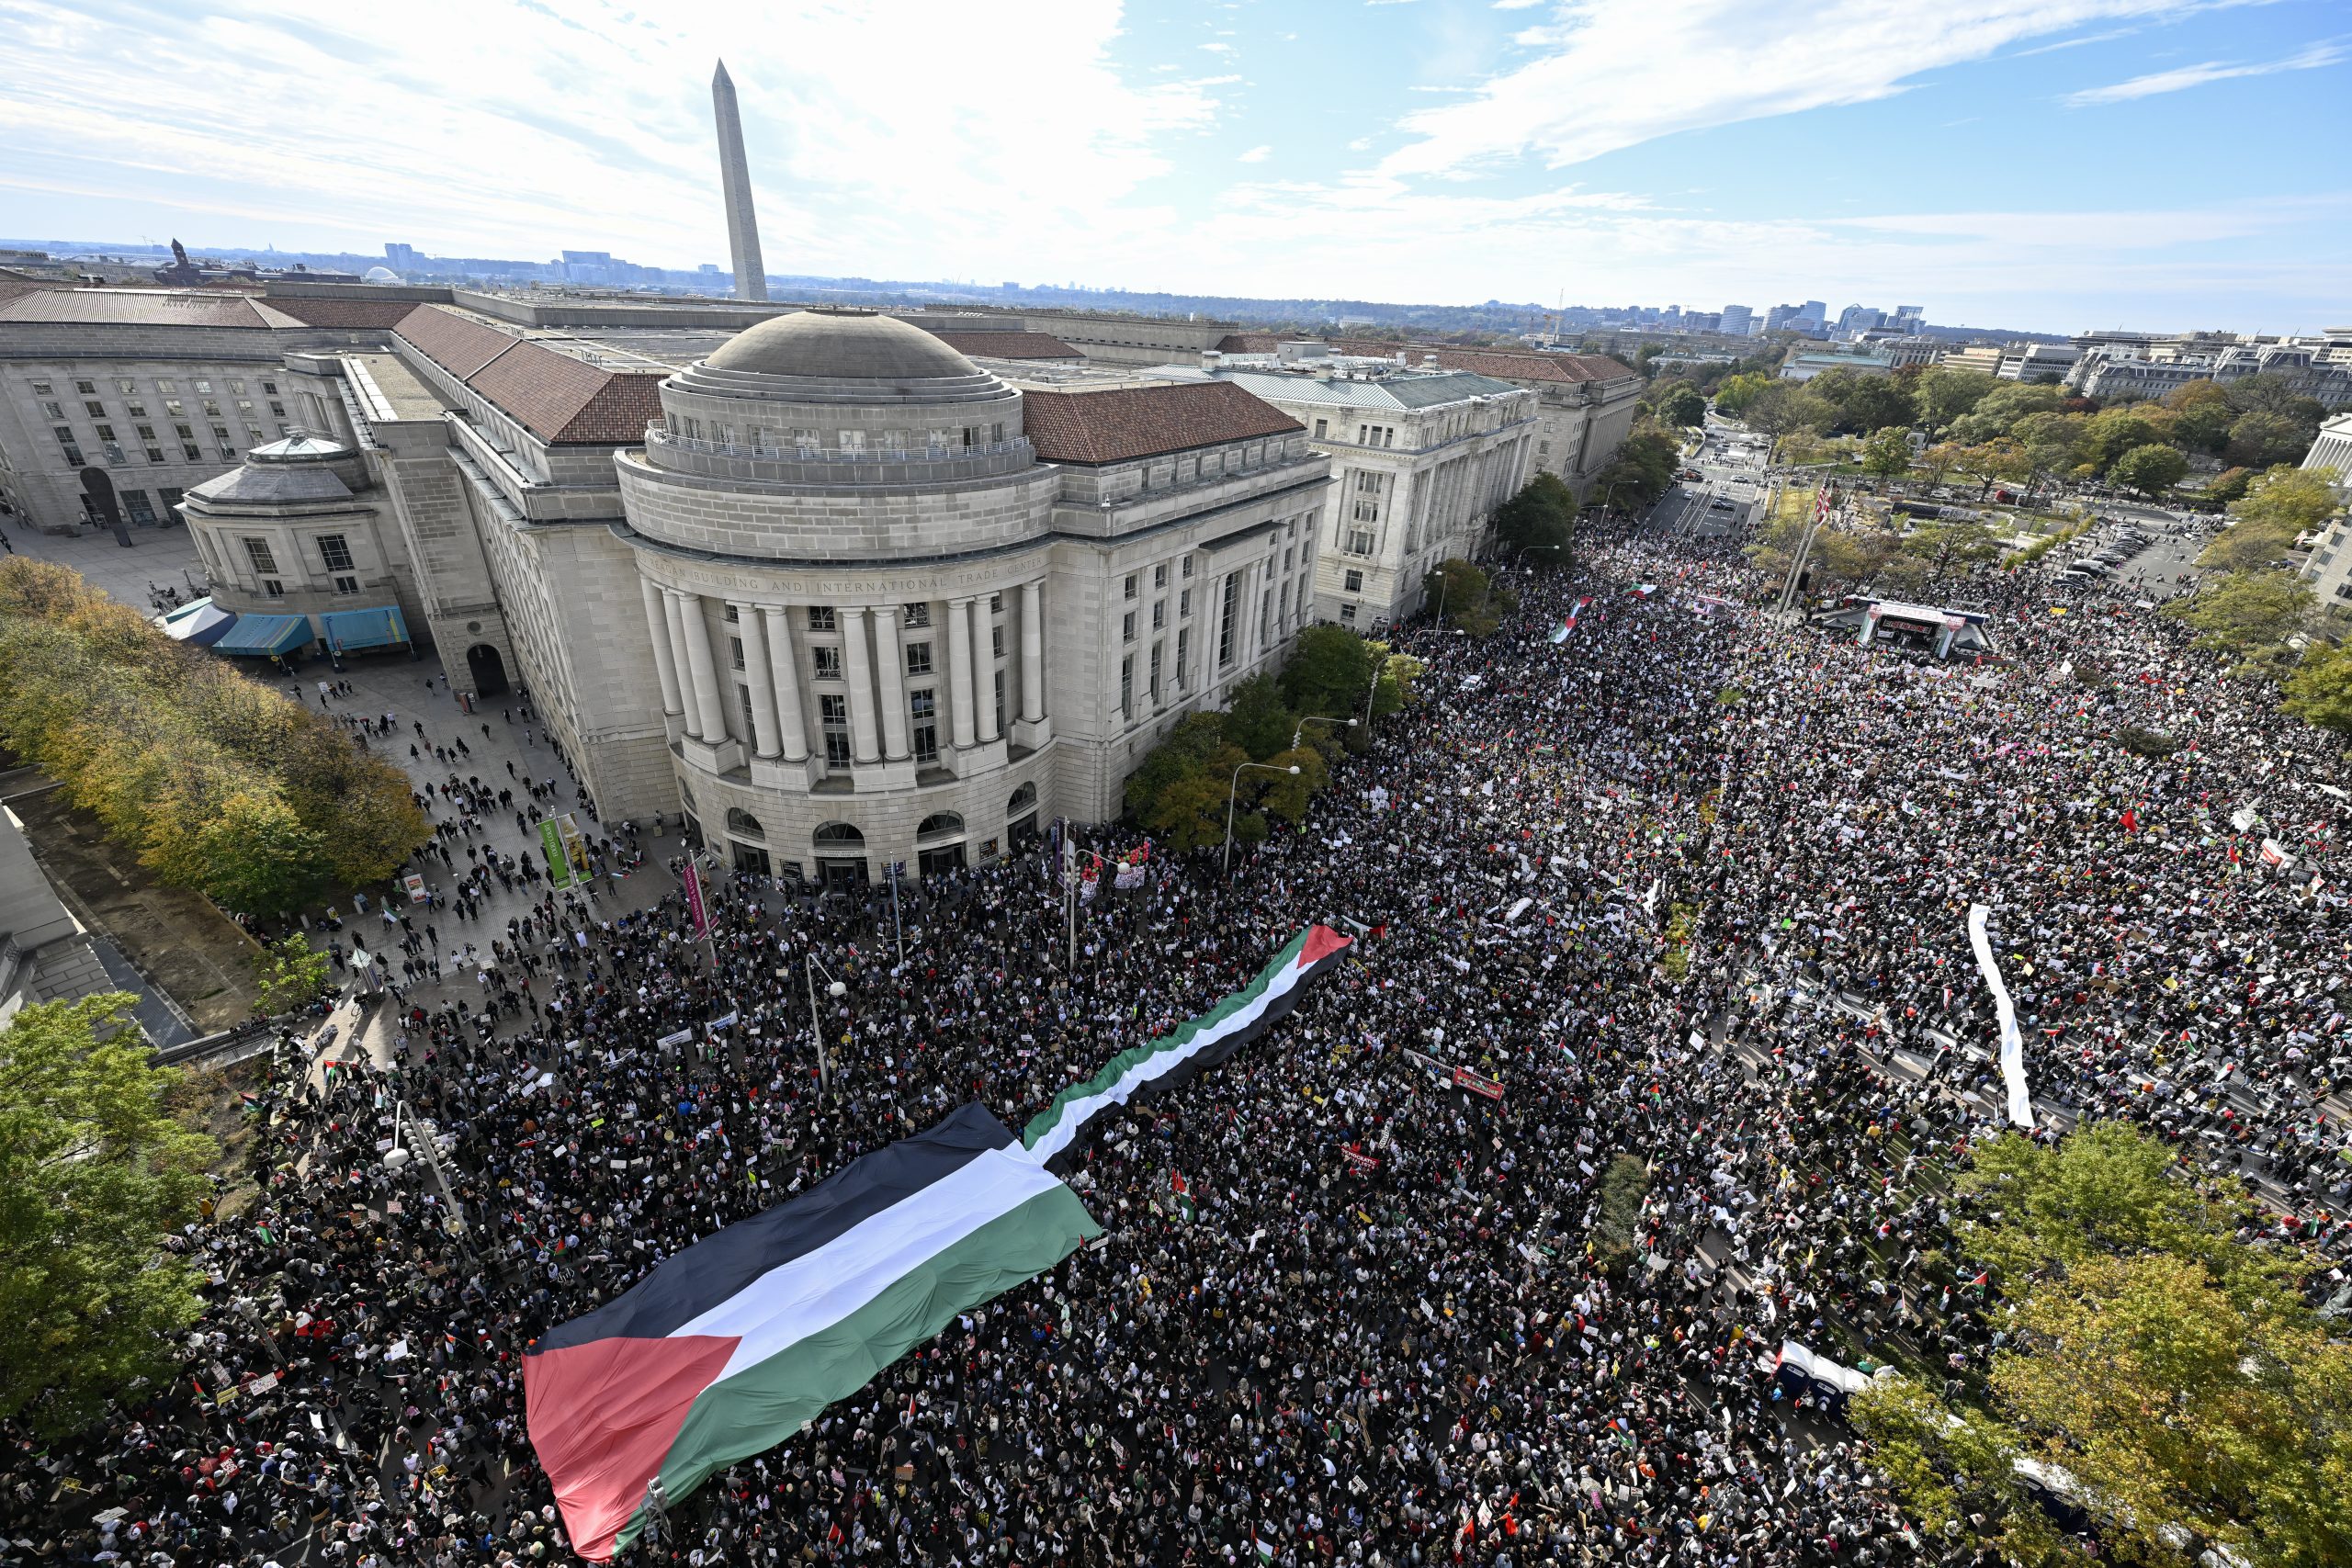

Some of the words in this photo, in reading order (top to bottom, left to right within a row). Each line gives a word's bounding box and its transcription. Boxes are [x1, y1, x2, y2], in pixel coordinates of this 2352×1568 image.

[650, 558, 685, 577] REAGAN
[694, 571, 759, 588] BUILDING
[772, 581, 802, 593] AND
[816, 578, 947, 593] INTERNATIONAL
[958, 568, 1000, 583] TRADE
[1007, 557, 1044, 576] CENTER
[544, 824, 554, 841] COURT
[549, 841, 559, 858] FOOD
[1341, 1147, 1376, 1166] DEMOCRATIC
